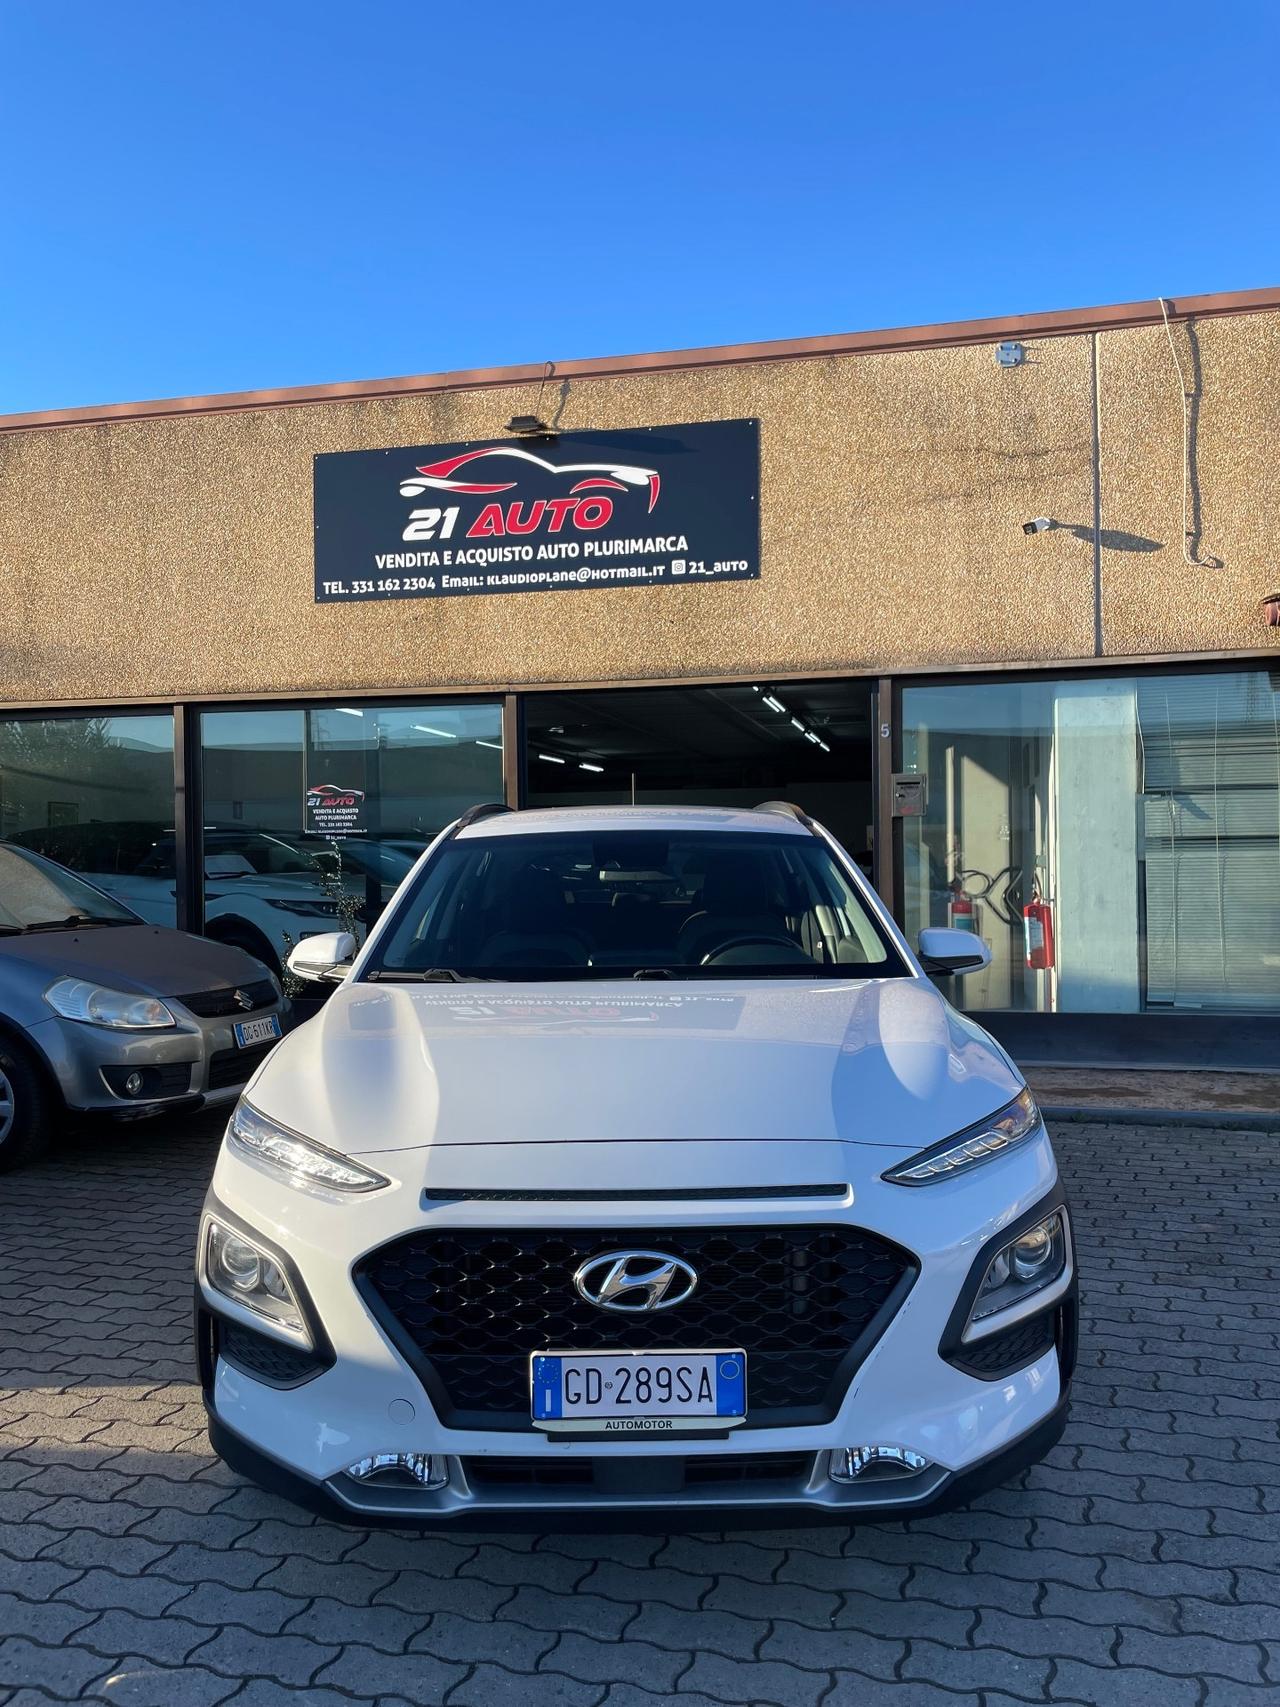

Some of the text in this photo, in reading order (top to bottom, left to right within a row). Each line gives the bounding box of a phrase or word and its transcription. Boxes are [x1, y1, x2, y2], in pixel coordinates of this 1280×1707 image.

[402, 496, 613, 541] 21 AUTO
[375, 535, 688, 569] VENDITA E ACQUISTO AUTO PLURIMARCA
[322, 581, 349, 594] TEL.
[352, 580, 375, 594] 331
[377, 578, 400, 591] 162
[403, 576, 436, 591] 2304
[881, 723, 890, 738] 5
[307, 796, 355, 806] 21 AUTO
[565, 1366, 714, 1405] GD 289SA
[605, 1420, 673, 1430] AUTOMOTOR
